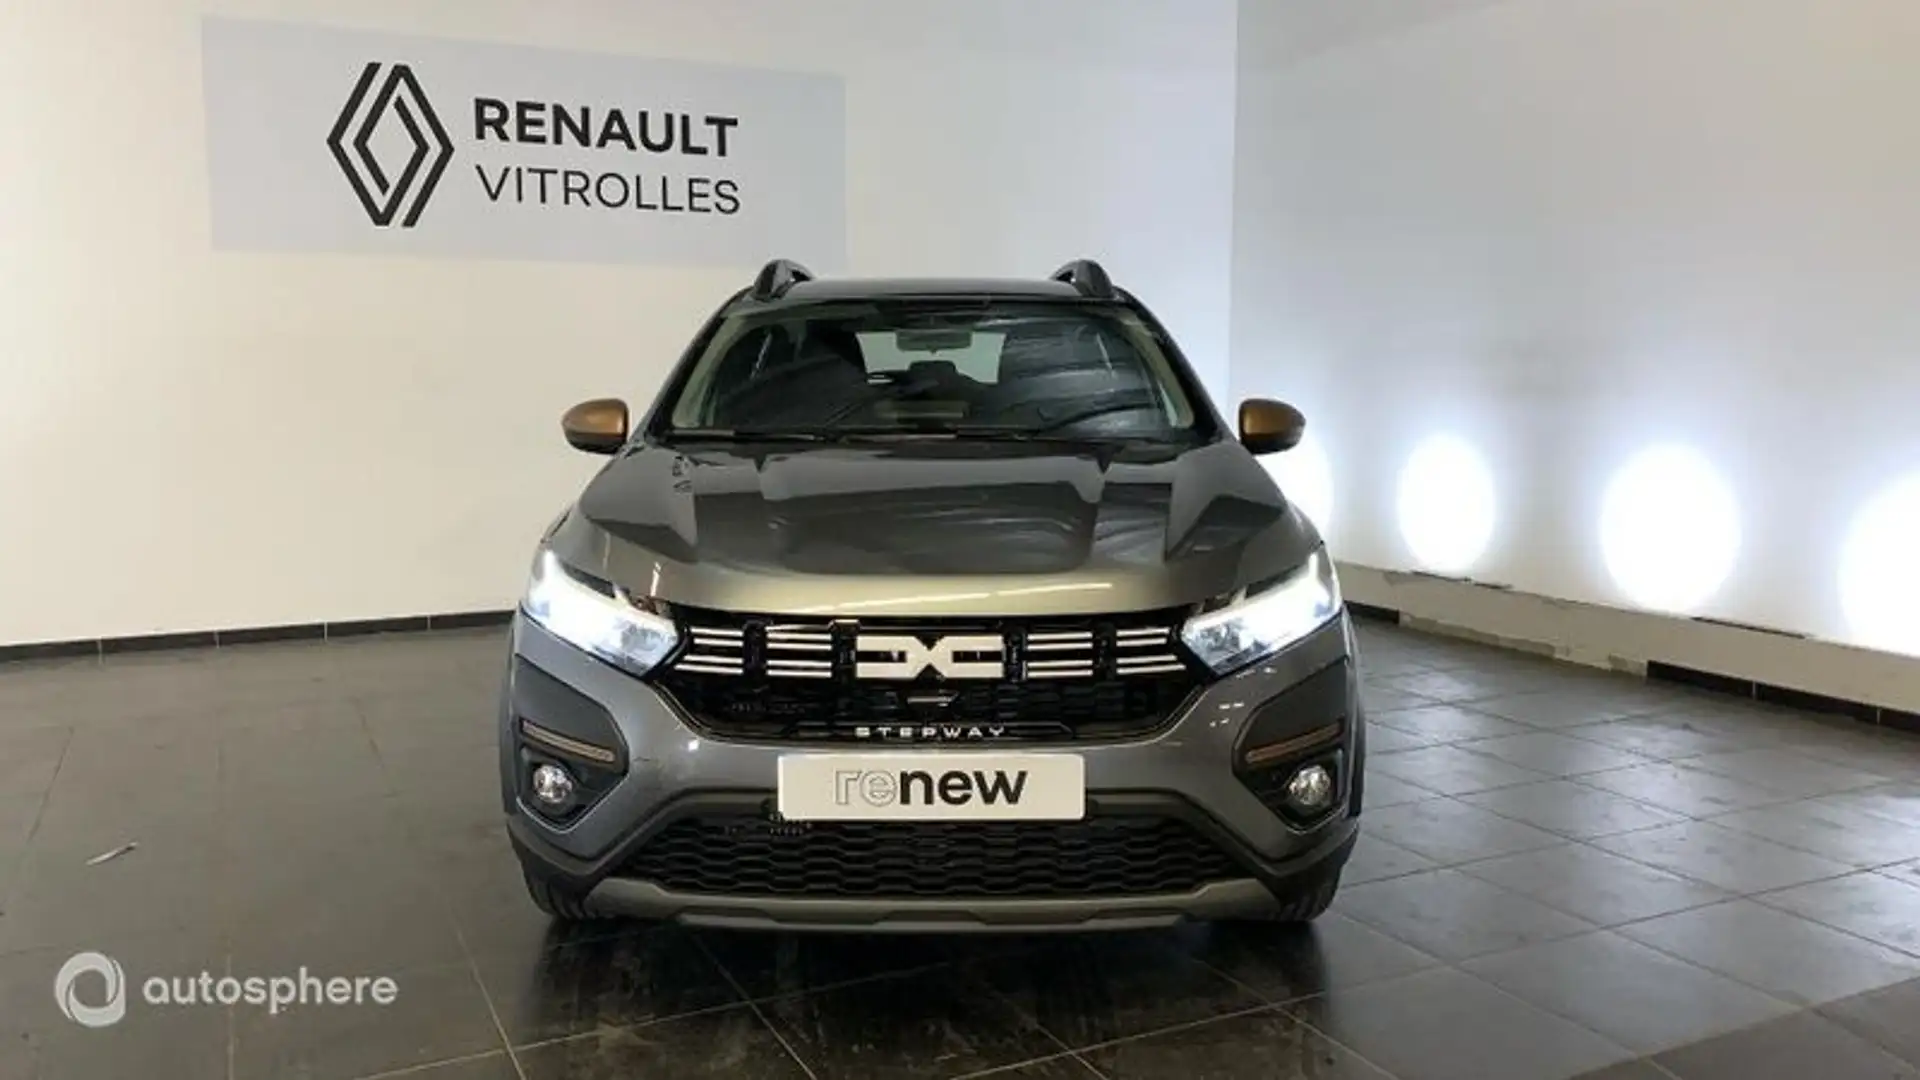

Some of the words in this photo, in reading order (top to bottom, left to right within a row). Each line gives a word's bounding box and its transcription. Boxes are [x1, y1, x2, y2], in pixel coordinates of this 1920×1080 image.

[474, 98, 739, 157] RENAULT
[476, 164, 740, 214] VITROLLES
[855, 726, 1005, 738] STEPWAY
[835, 769, 1028, 806] renew
